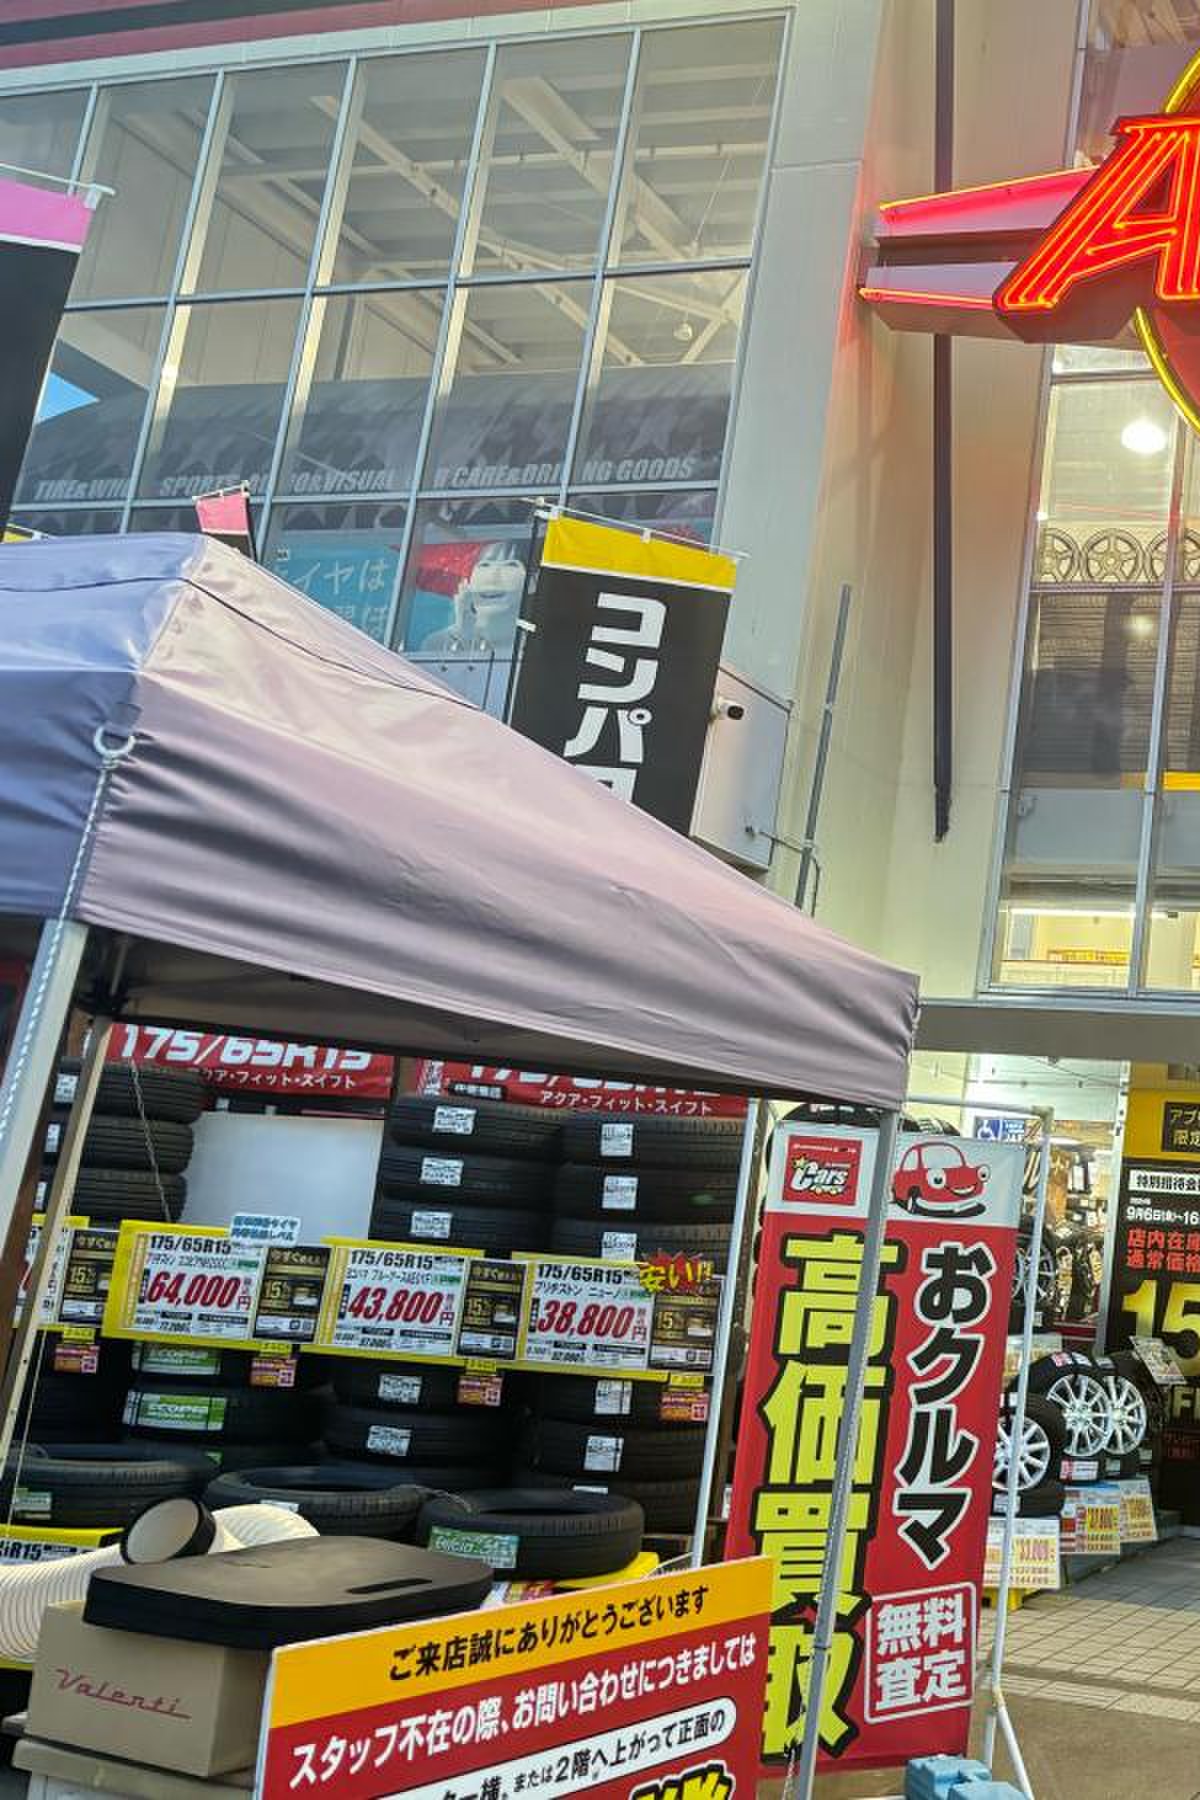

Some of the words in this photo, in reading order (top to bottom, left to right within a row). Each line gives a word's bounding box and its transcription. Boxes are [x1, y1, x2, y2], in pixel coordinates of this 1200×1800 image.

[151, 1234, 232, 1255] 175/65R15
[351, 1249, 434, 1271] 175/65R15
[538, 1263, 623, 1285] 175/65R15
[893, 1242, 996, 1570] おクルマ
[389, 1585, 709, 1682] ご来店誠にありがとうございます
[56, 1669, 192, 1720] Valenti
[289, 1632, 757, 1790] スタッフ不在の際、お問い合わせにつきましては
